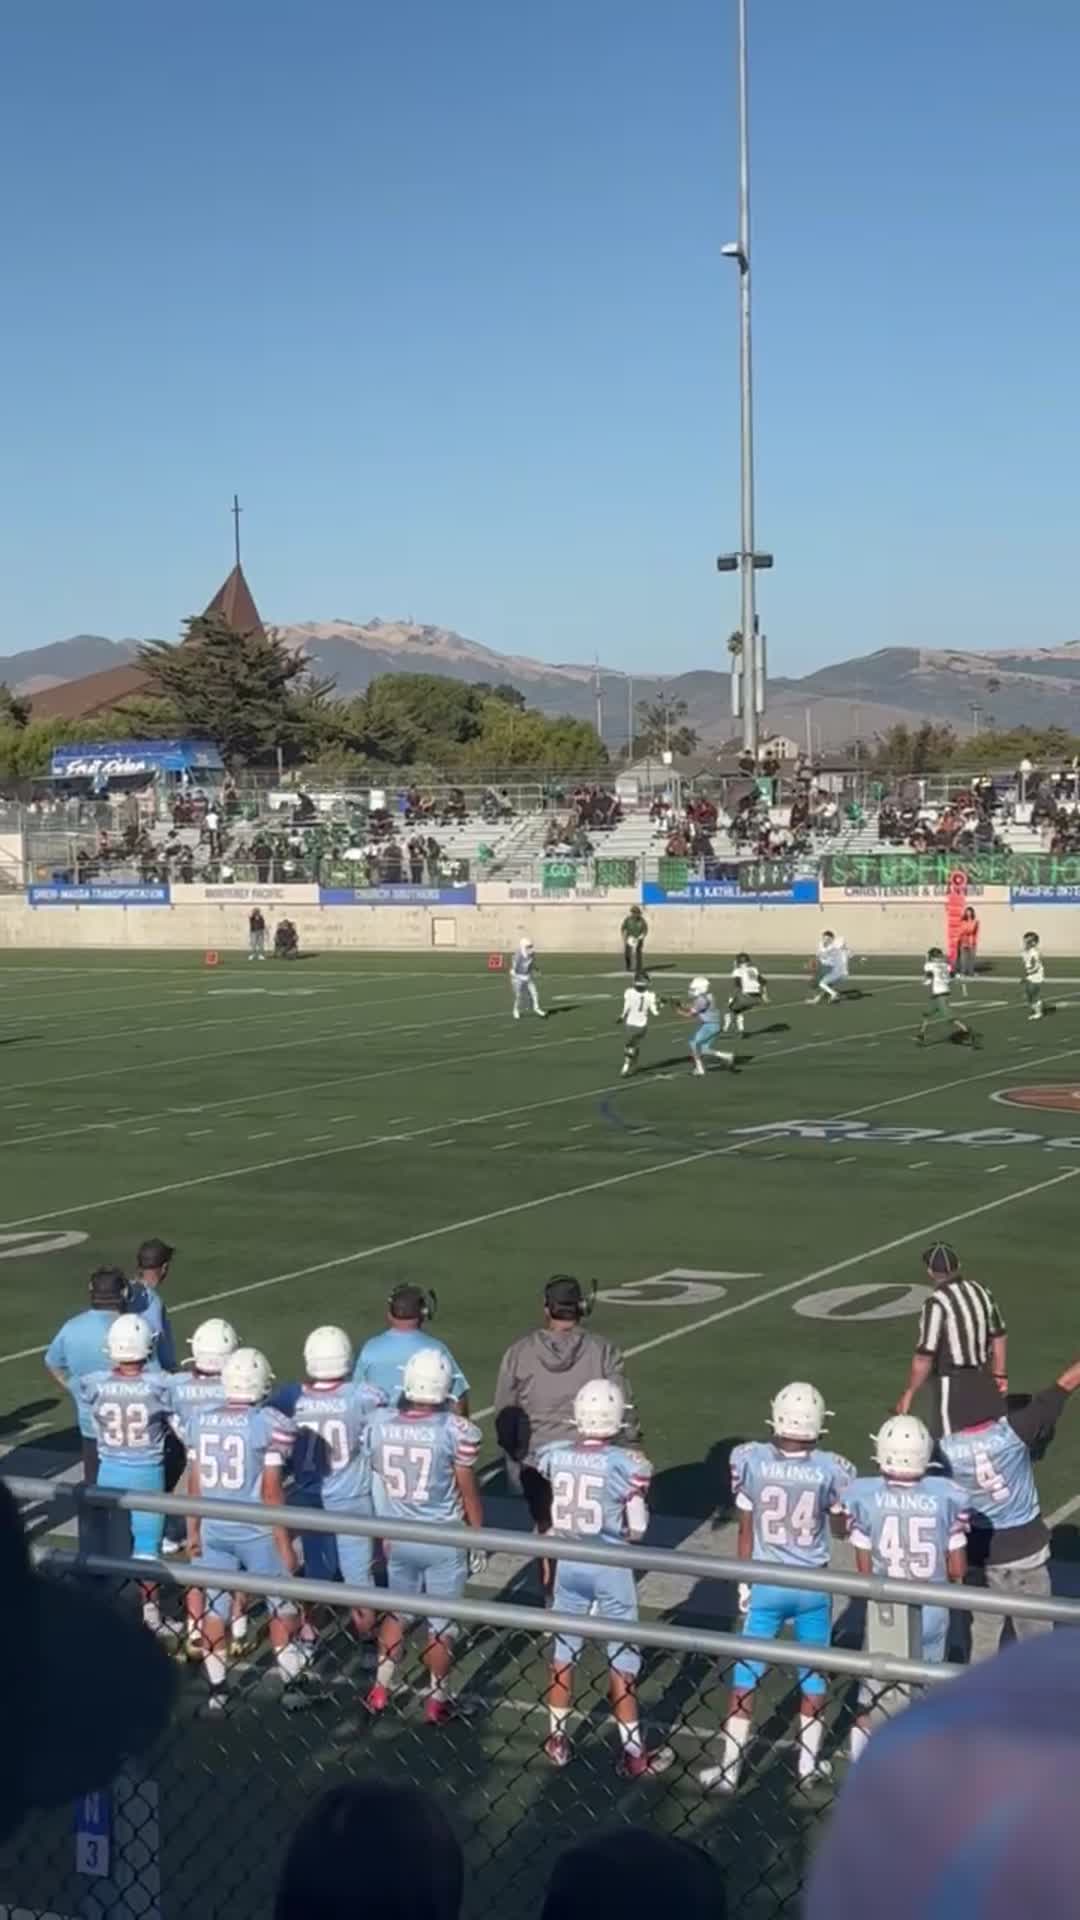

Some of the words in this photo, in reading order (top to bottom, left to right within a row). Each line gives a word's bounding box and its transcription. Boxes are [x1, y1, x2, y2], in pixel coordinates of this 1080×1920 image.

[550, 862, 572, 878] GO
[97, 1382, 152, 1396] VIKINGS
[98, 1402, 151, 1448] 32
[199, 1412, 250, 1427] VIKINGS
[382, 1423, 435, 1441] VIKINGS
[199, 1433, 245, 1489] 53
[382, 1444, 432, 1501] 57
[551, 1451, 609, 1471] VIKINGS
[760, 1460, 825, 1483] VIKINGS
[974, 1449, 1010, 1503] 4
[550, 1470, 604, 1535] 25
[760, 1485, 818, 1546] 24
[873, 1490, 938, 1513] VIKINGS
[878, 1514, 937, 1579] 45
[86, 1840, 99, 1868] 3
